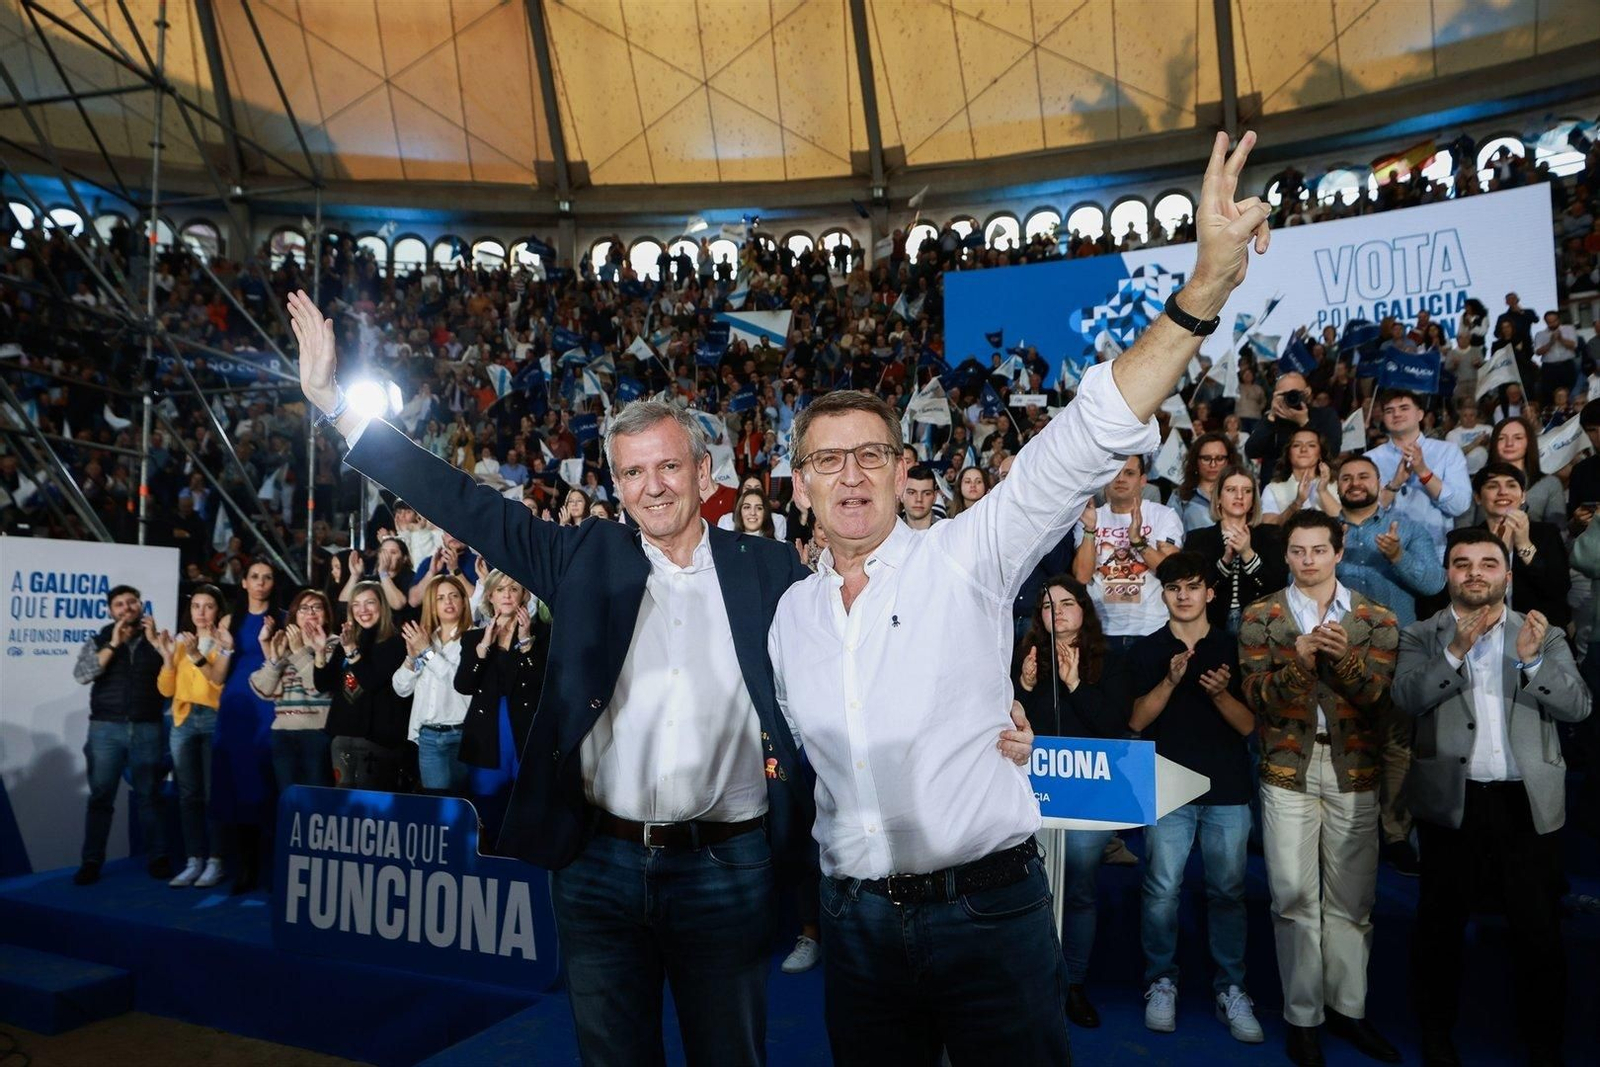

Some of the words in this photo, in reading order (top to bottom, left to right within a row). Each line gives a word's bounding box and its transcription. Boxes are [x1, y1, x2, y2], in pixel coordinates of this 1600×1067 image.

[1314, 228, 1472, 305] VOTA
[1374, 290, 1470, 324] GALICIA
[1095, 525, 1152, 539] LEGED
[11, 570, 23, 592] A
[29, 571, 110, 594] GALICIA
[11, 596, 49, 620] QUE
[54, 597, 153, 619] FUNCA
[8, 628, 62, 643] ALFONSO
[32, 648, 69, 656] GALICIA
[290, 812, 302, 848] A
[308, 813, 400, 859] GALICIA
[405, 822, 449, 868] QUE
[285, 854, 537, 960] FUNCIONA
